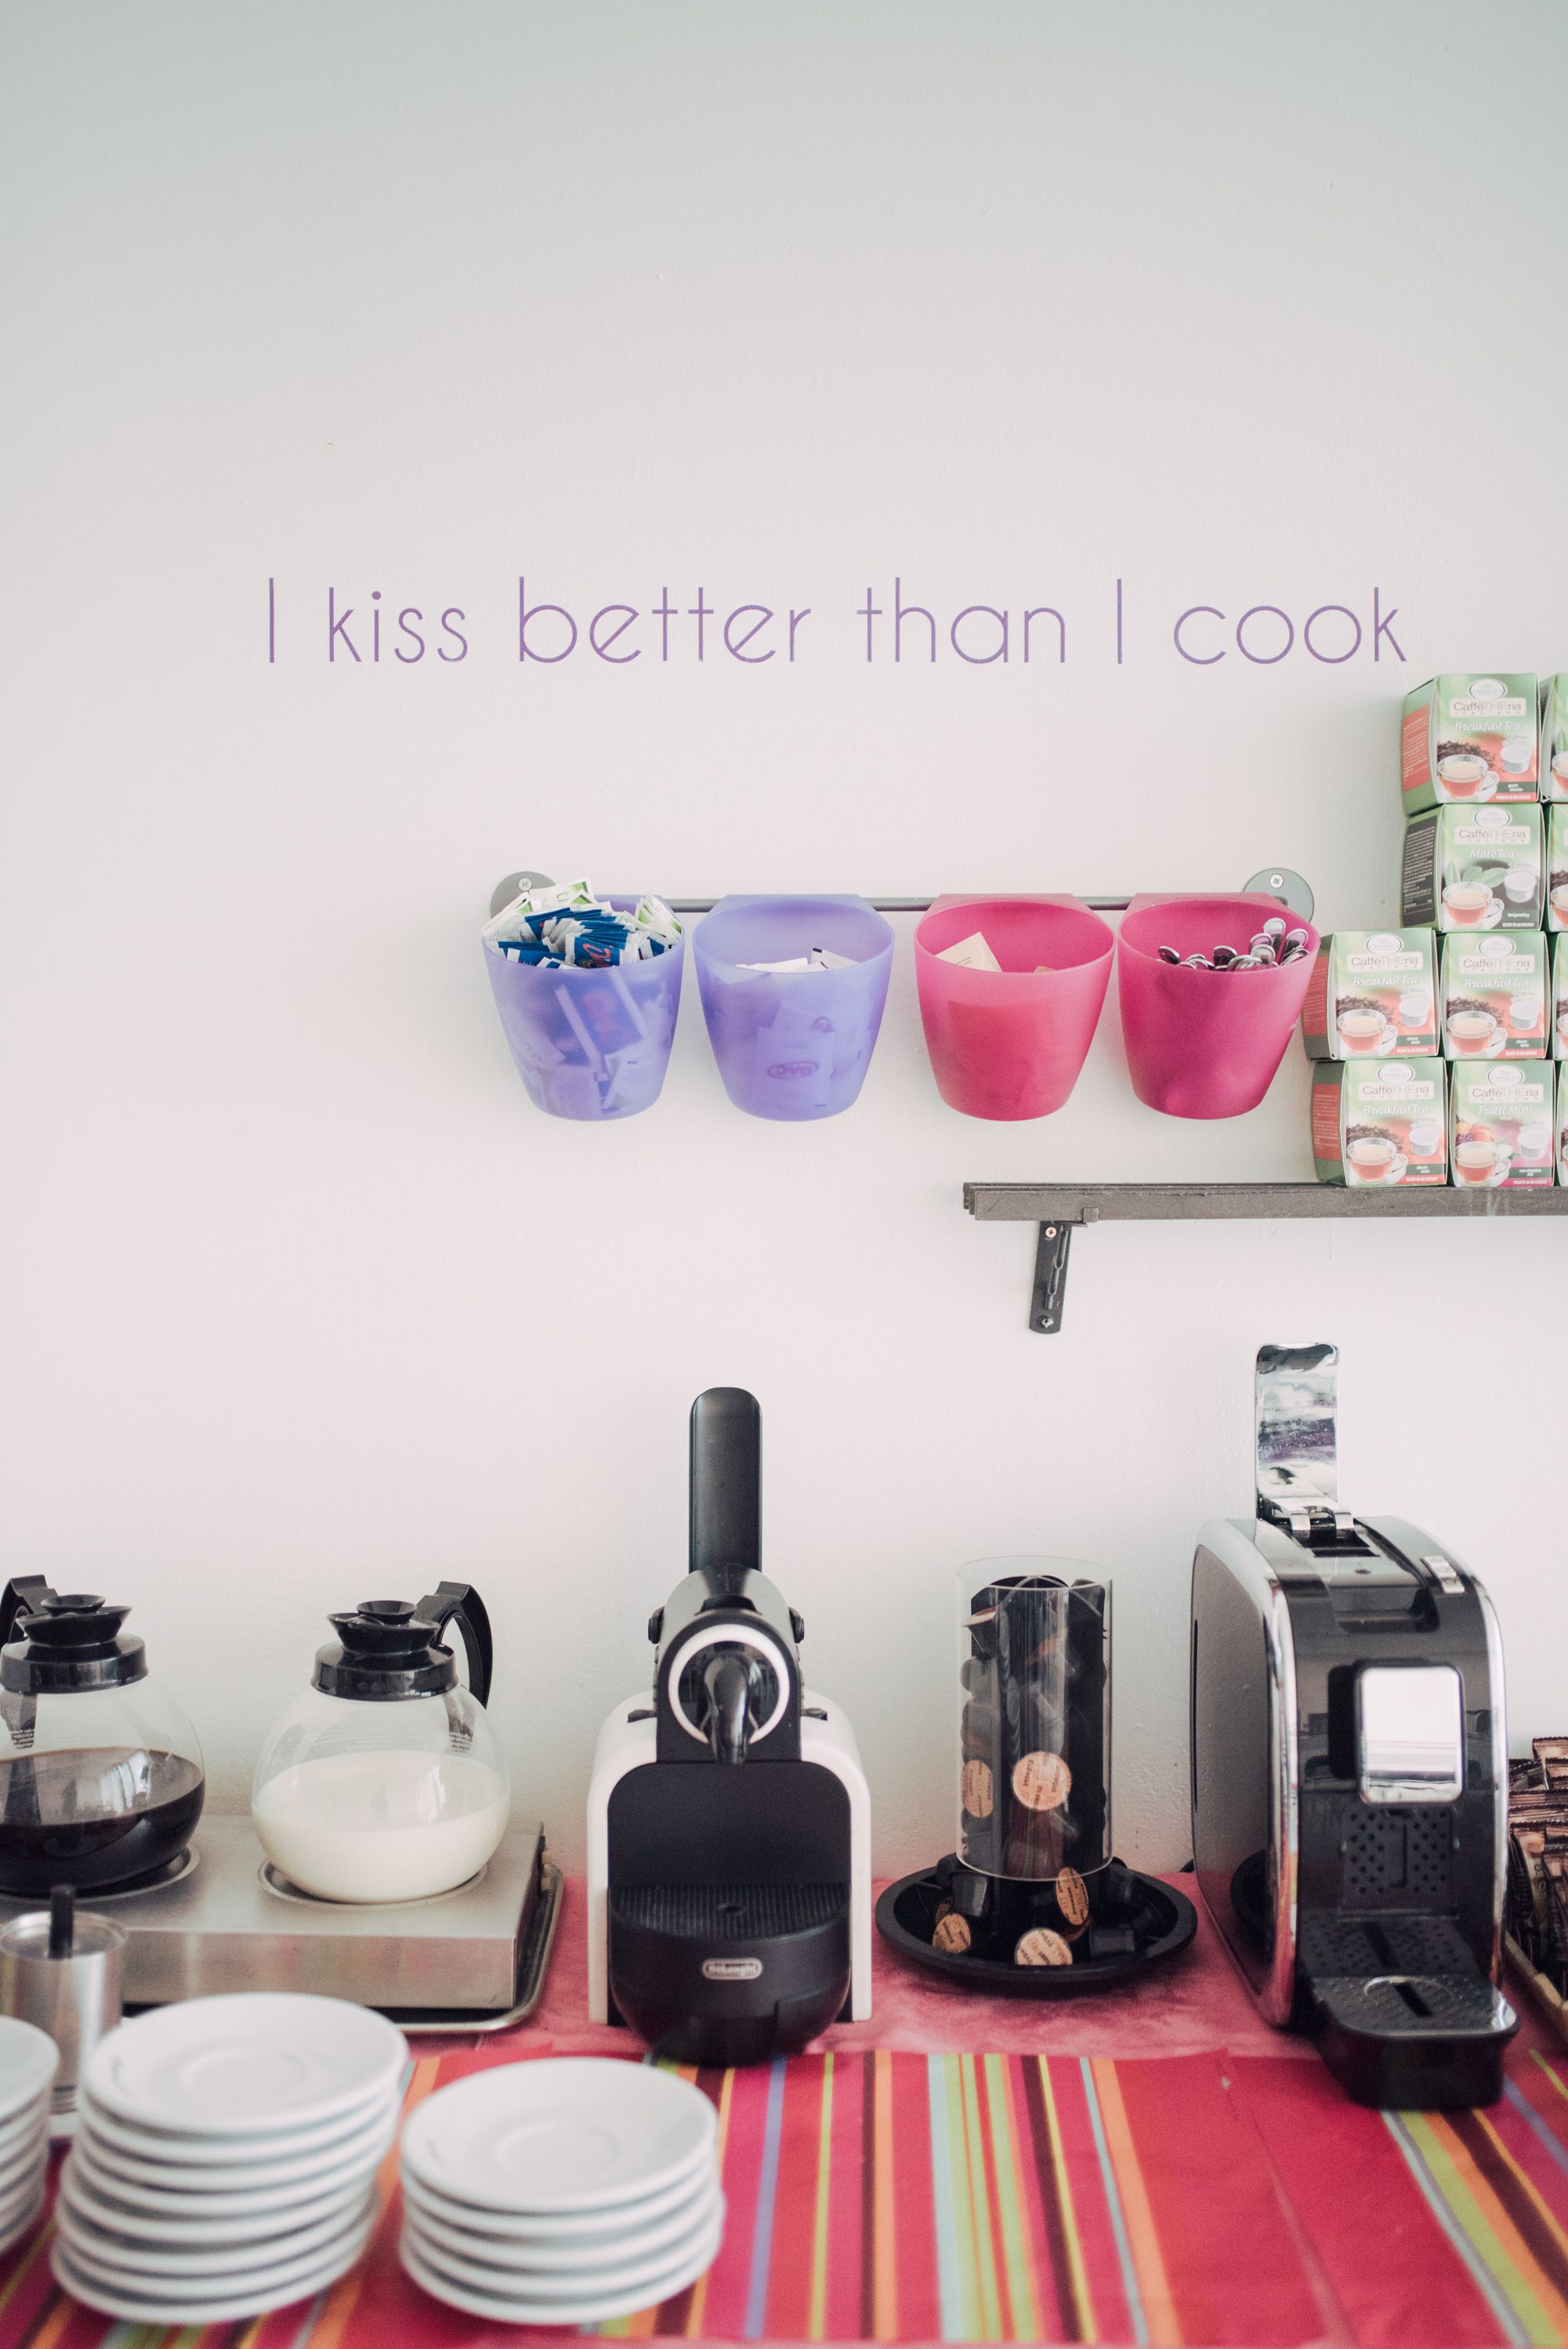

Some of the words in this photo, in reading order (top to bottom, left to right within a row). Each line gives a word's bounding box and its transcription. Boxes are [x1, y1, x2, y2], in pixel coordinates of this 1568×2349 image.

[268, 577, 275, 664] I
[328, 586, 469, 664] kiss
[518, 575, 812, 665] better
[856, 576, 1066, 664] than
[1116, 578, 1123, 665] I
[1173, 586, 1407, 665] cook
[1454, 721, 1502, 732] Breakfast
[1504, 720, 1520, 730] Tea
[1497, 849, 1515, 859] Tea
[1353, 976, 1400, 988] Breakfast
[1403, 974, 1418, 985] Tea
[1465, 977, 1511, 989] Breakfast
[1513, 977, 1530, 988] Tea
[1363, 1104, 1410, 1115] Breakfast
[1413, 1104, 1430, 1114] Tea
[1479, 1104, 1506, 1115] Frutti
[1508, 1104, 1533, 1115] Misti
